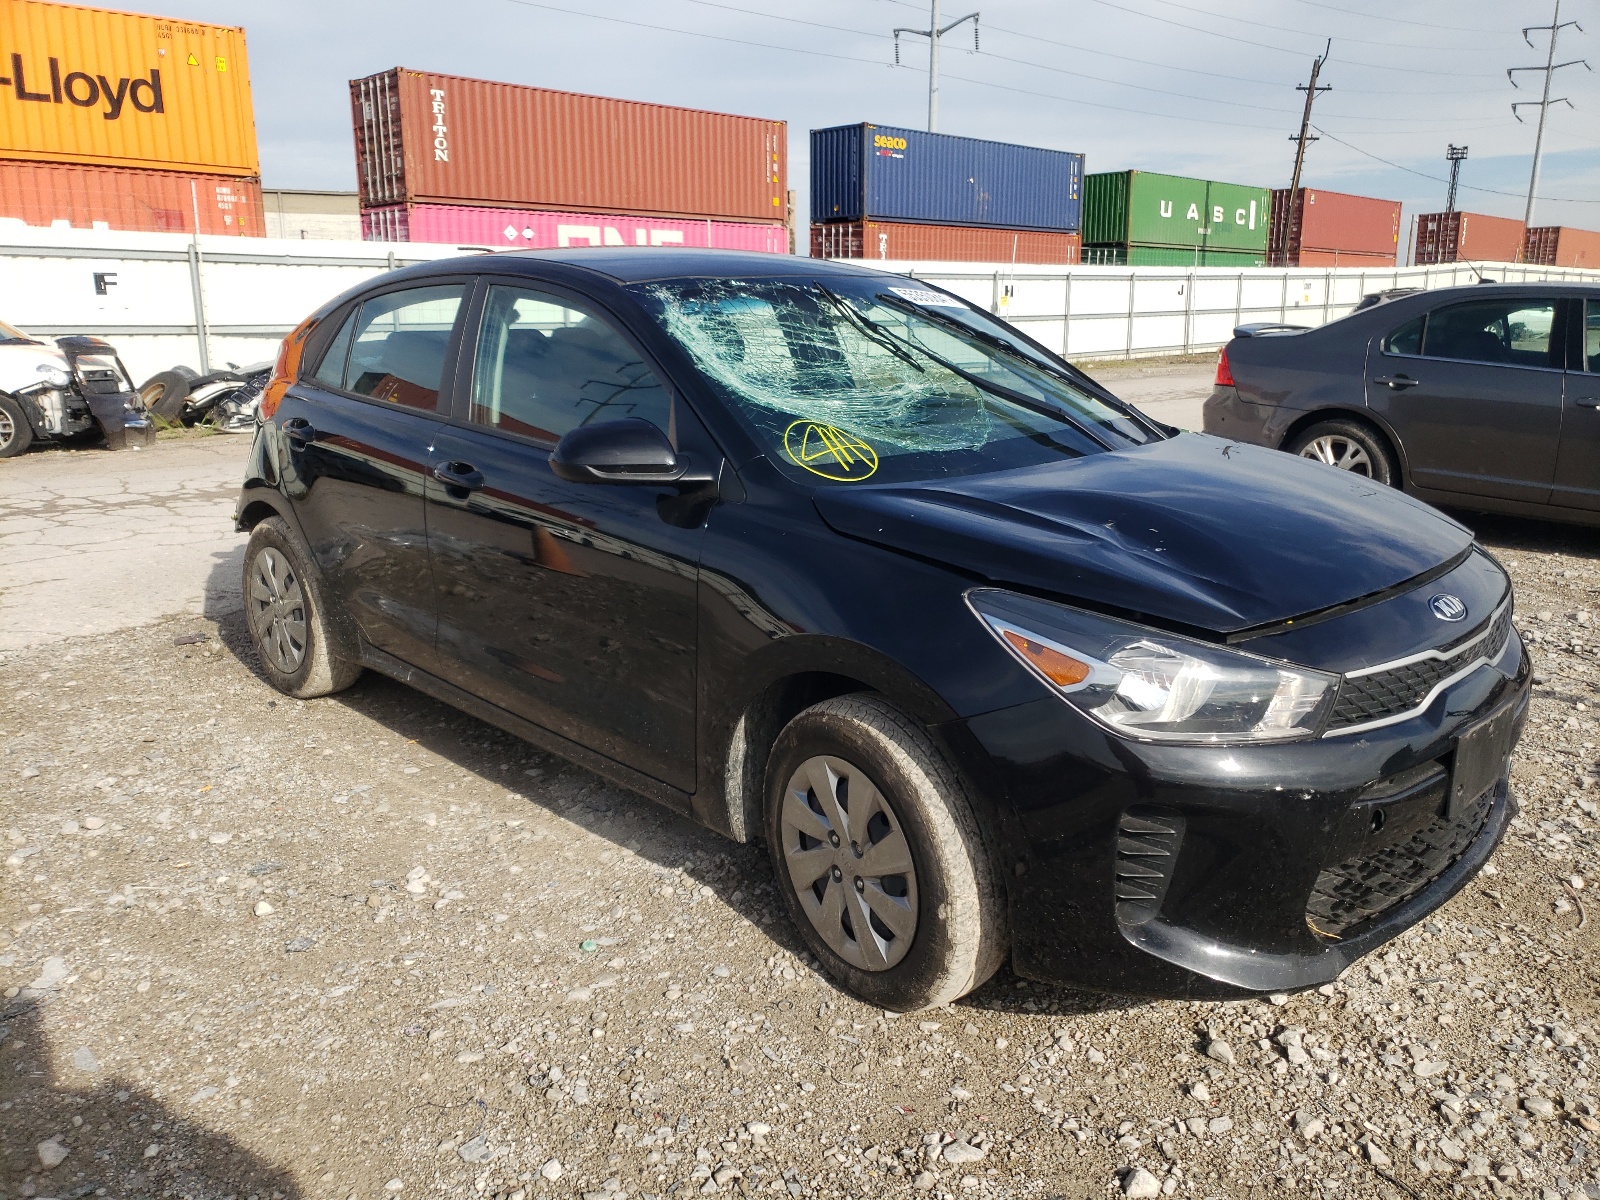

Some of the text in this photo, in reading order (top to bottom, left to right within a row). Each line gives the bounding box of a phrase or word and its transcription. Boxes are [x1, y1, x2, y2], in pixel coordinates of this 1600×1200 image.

[430, 89, 448, 162] TRITON
[874, 134, 907, 150] seaco
[1178, 284, 1184, 296] J
